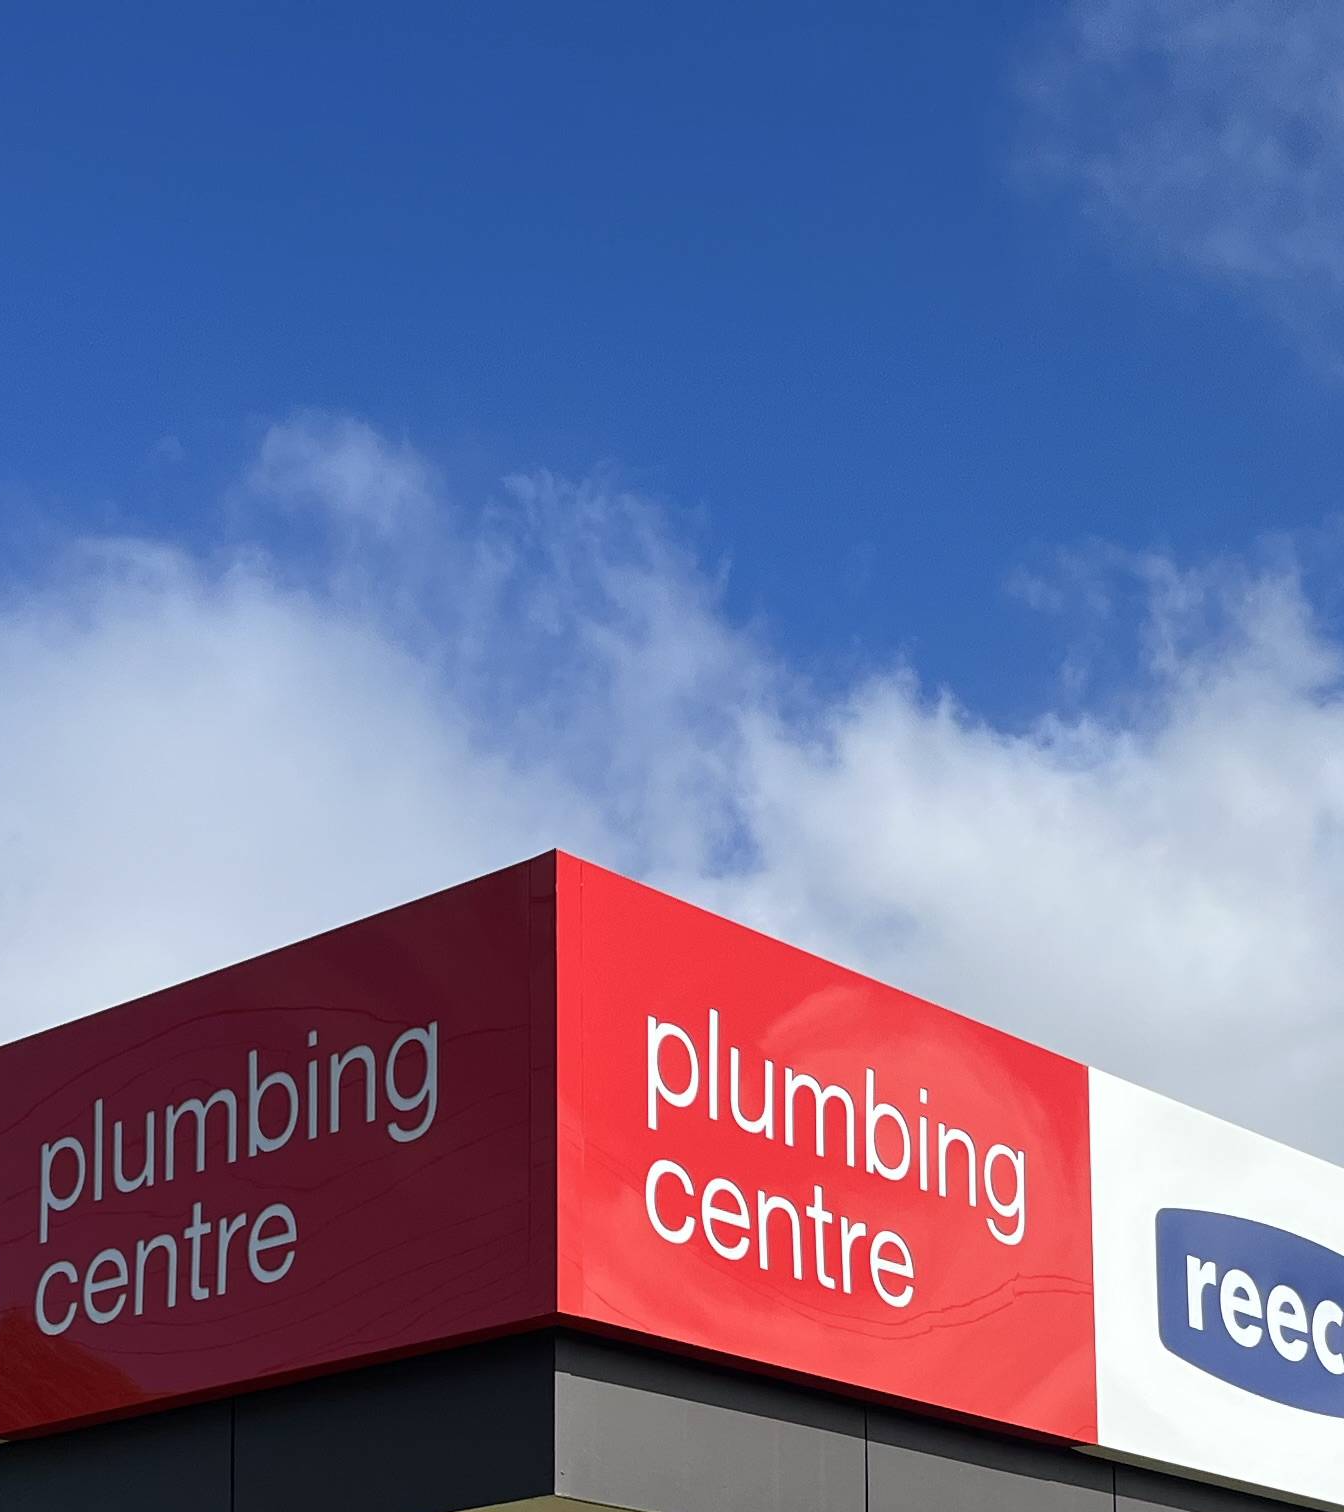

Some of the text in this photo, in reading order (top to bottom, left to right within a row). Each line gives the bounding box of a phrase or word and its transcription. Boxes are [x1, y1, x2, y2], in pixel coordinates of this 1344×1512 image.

[38, 1020, 439, 1244] plumbing
[646, 1008, 1026, 1246] plumbing
[35, 1201, 299, 1336] centre
[644, 1157, 915, 1309] centre
